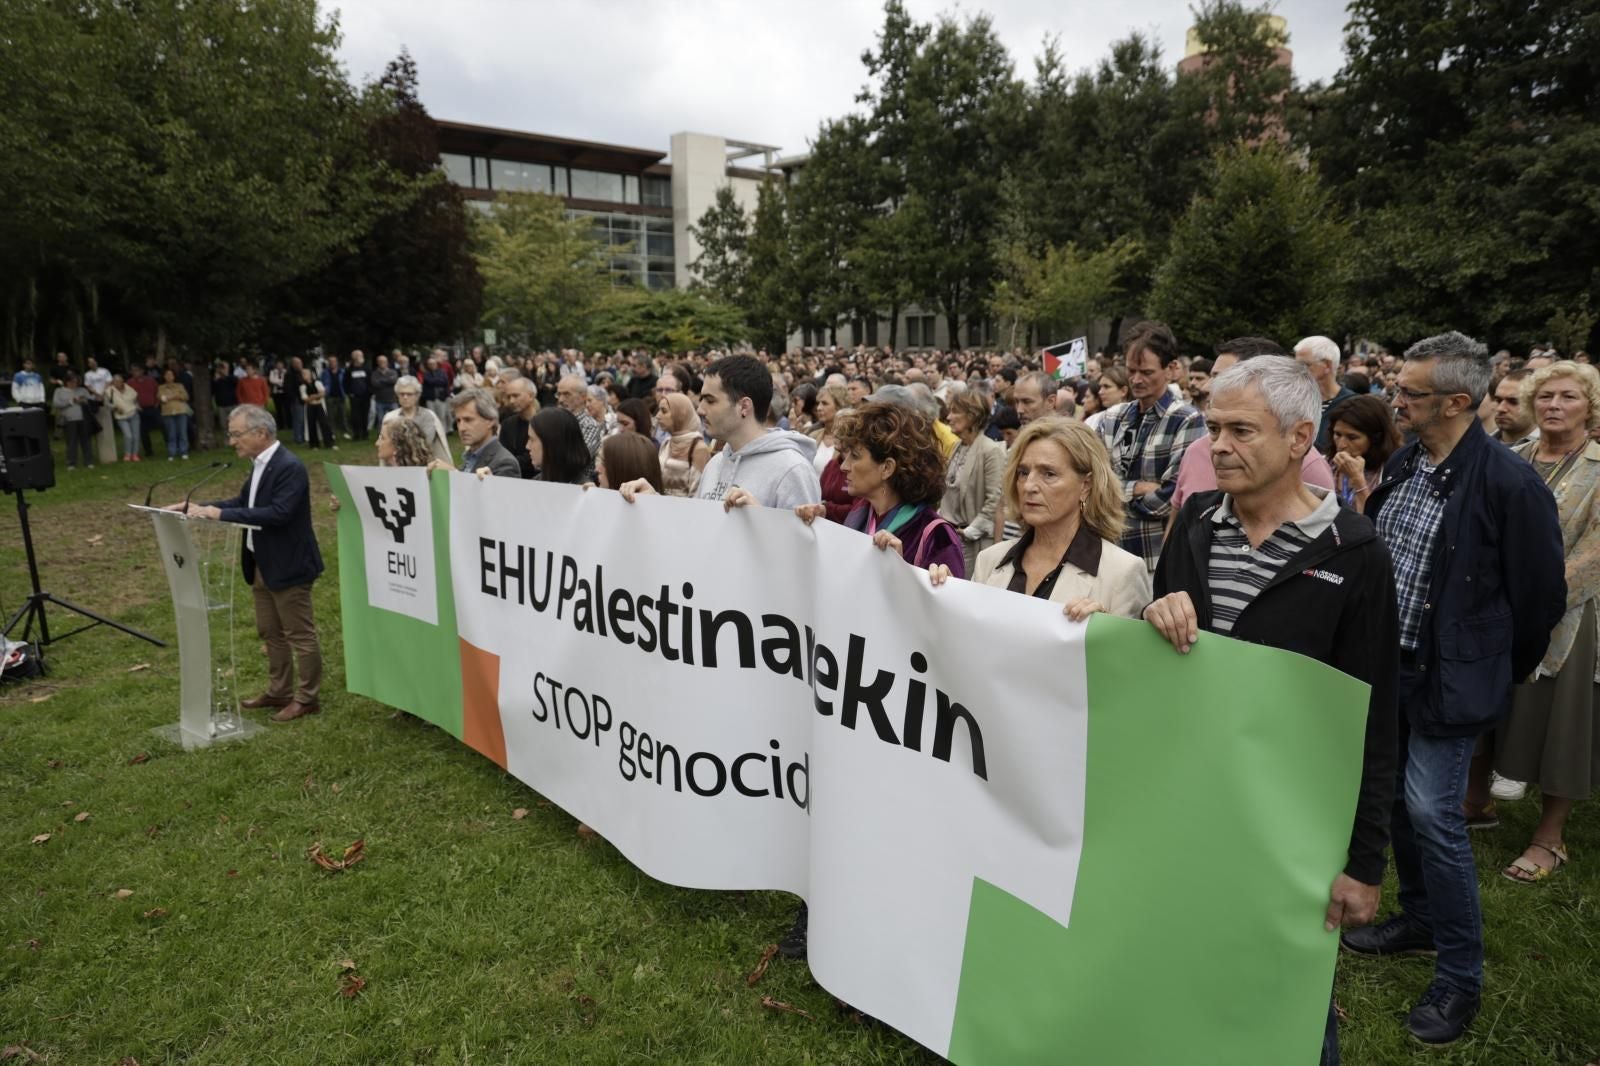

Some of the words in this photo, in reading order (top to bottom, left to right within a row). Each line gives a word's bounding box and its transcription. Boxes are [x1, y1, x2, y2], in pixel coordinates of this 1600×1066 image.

[387, 550, 417, 579] EHU
[532, 671, 613, 747] STOP
[618, 720, 811, 816] genocid
